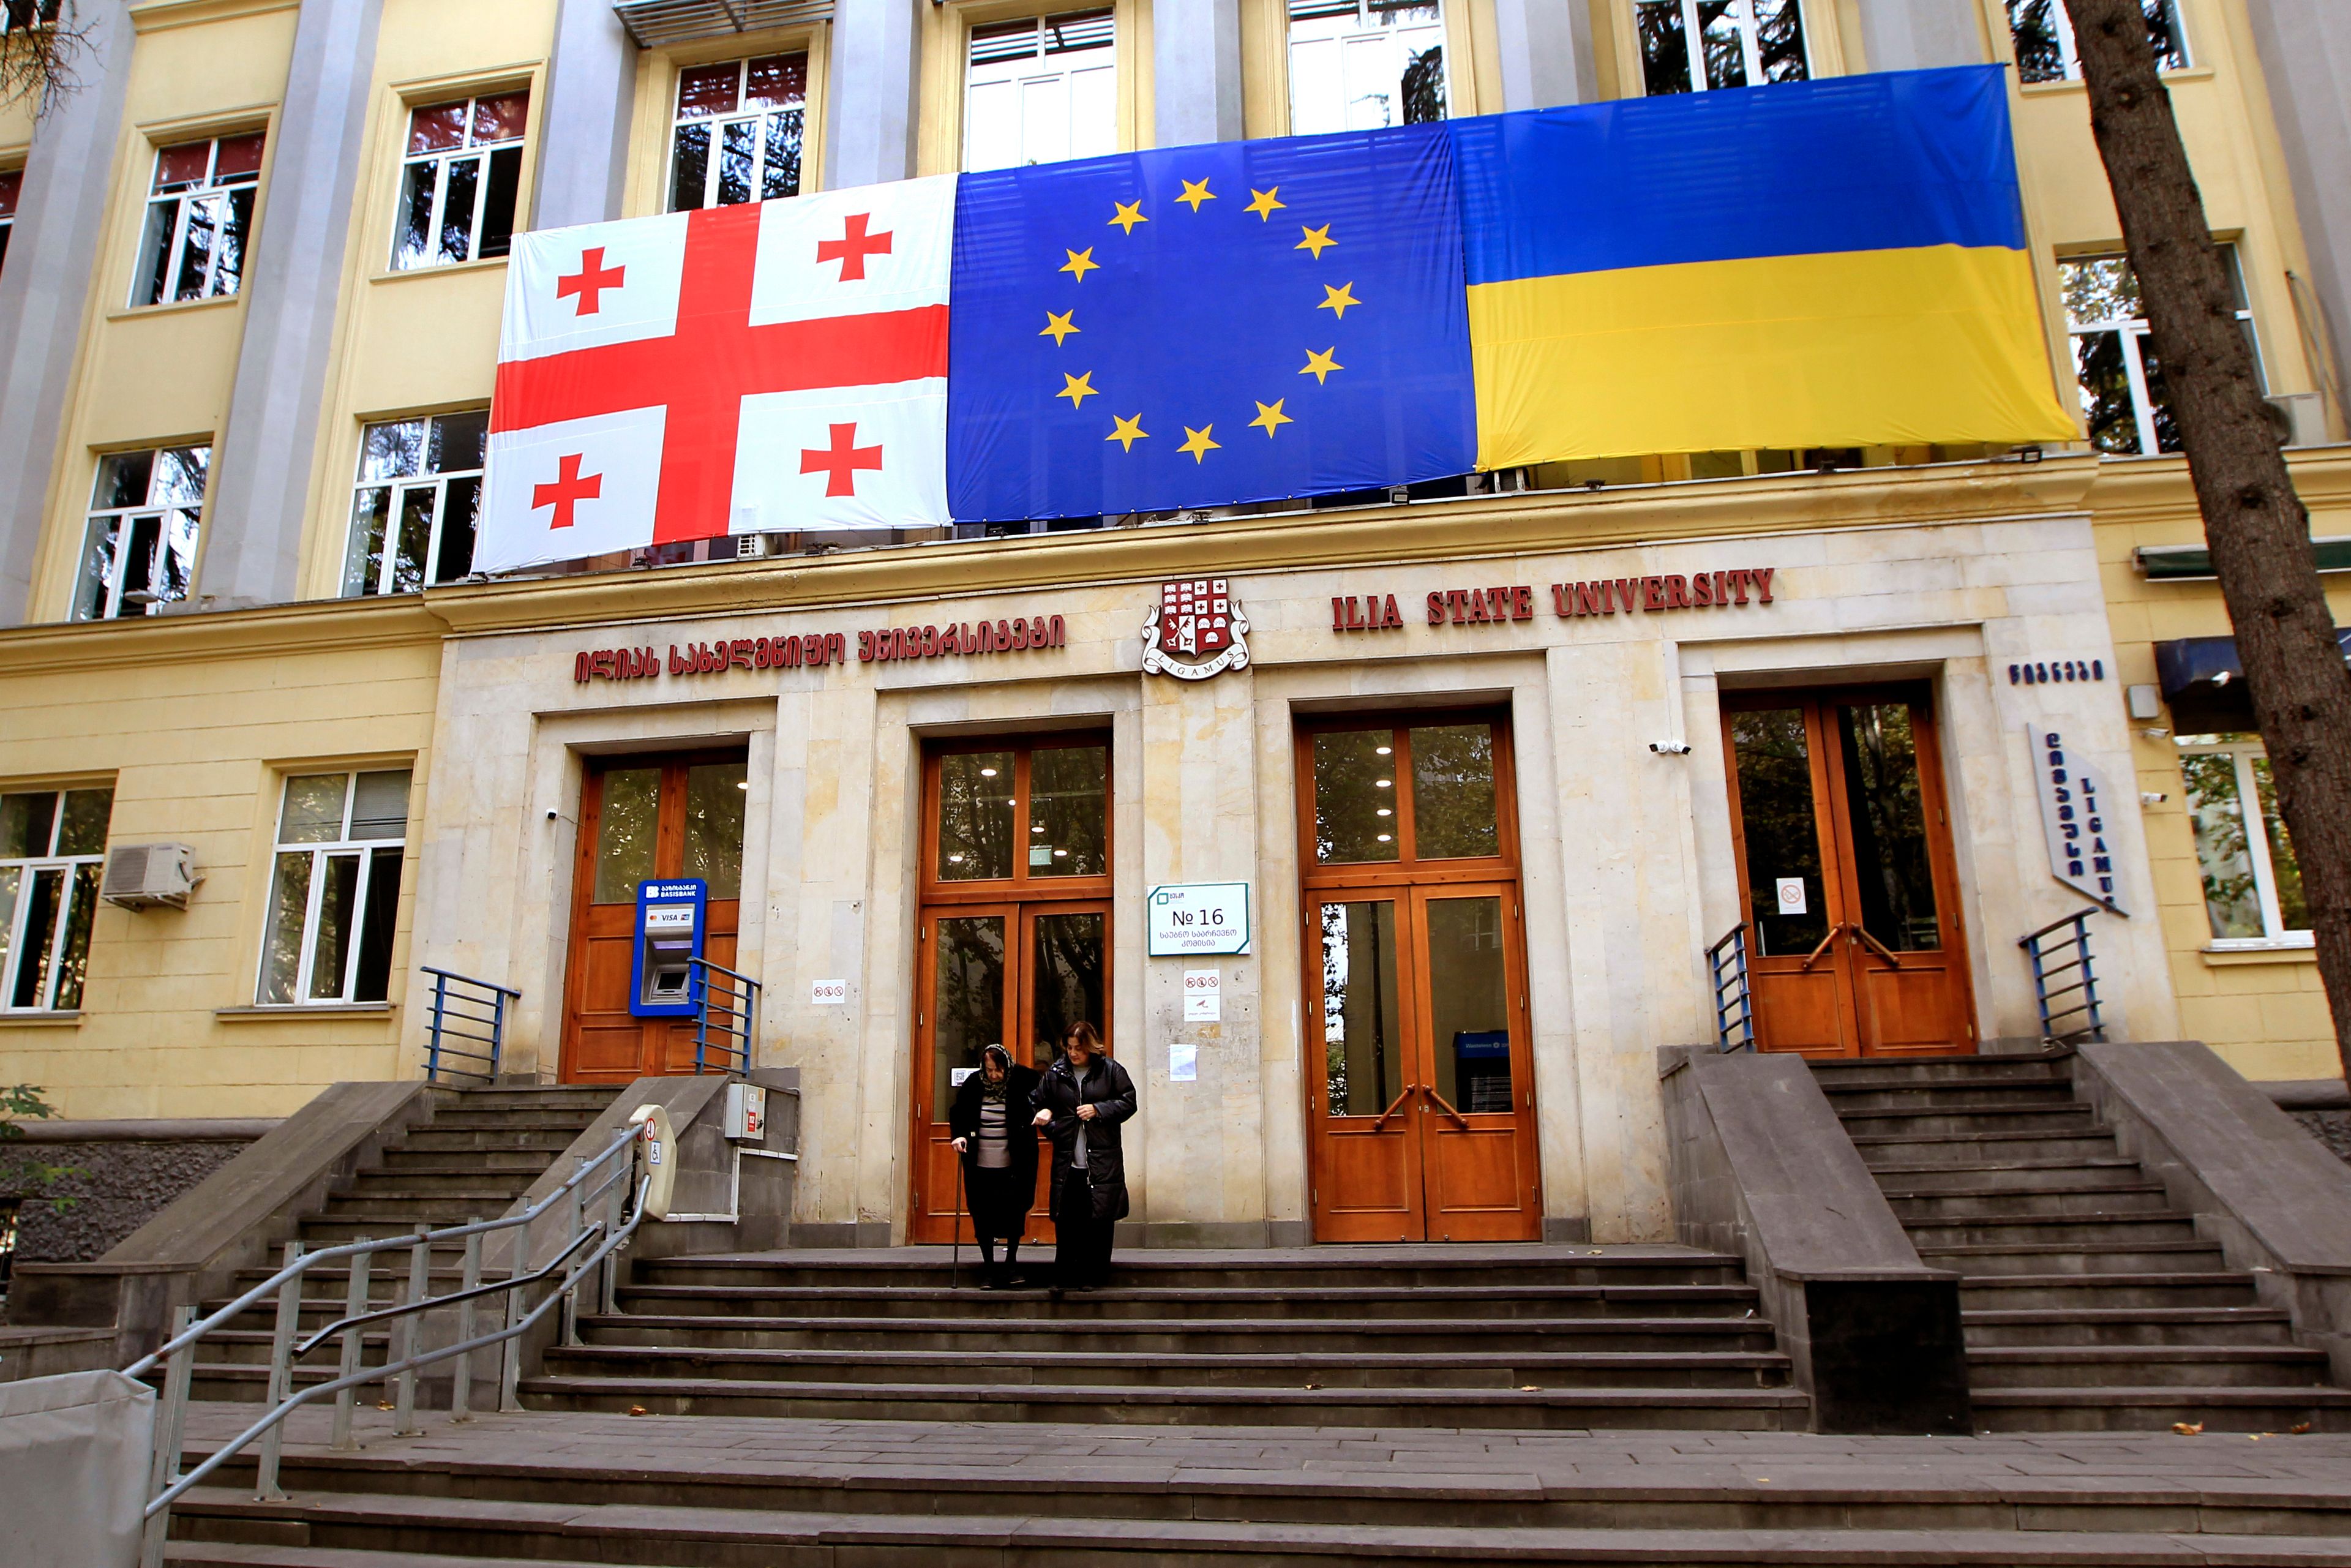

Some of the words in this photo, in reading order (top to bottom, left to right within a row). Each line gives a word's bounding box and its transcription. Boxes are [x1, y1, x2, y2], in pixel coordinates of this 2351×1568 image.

[1332, 594, 1404, 631] ILIA
[1427, 585, 1532, 626] STATE
[1551, 568, 1775, 618] UNIVERSITY
[574, 647, 660, 683] ილიას
[668, 632, 845, 675] სახელმწიფო
[858, 614, 1065, 662] უნივერსიტეტი
[1158, 650, 1234, 677] LIGAMUS
[1199, 908, 1224, 926] 16
[1160, 930, 1190, 939] საუბნო
[1191, 929, 1237, 938] საარჩევნო
[1181, 939, 1216, 948] კომისია
